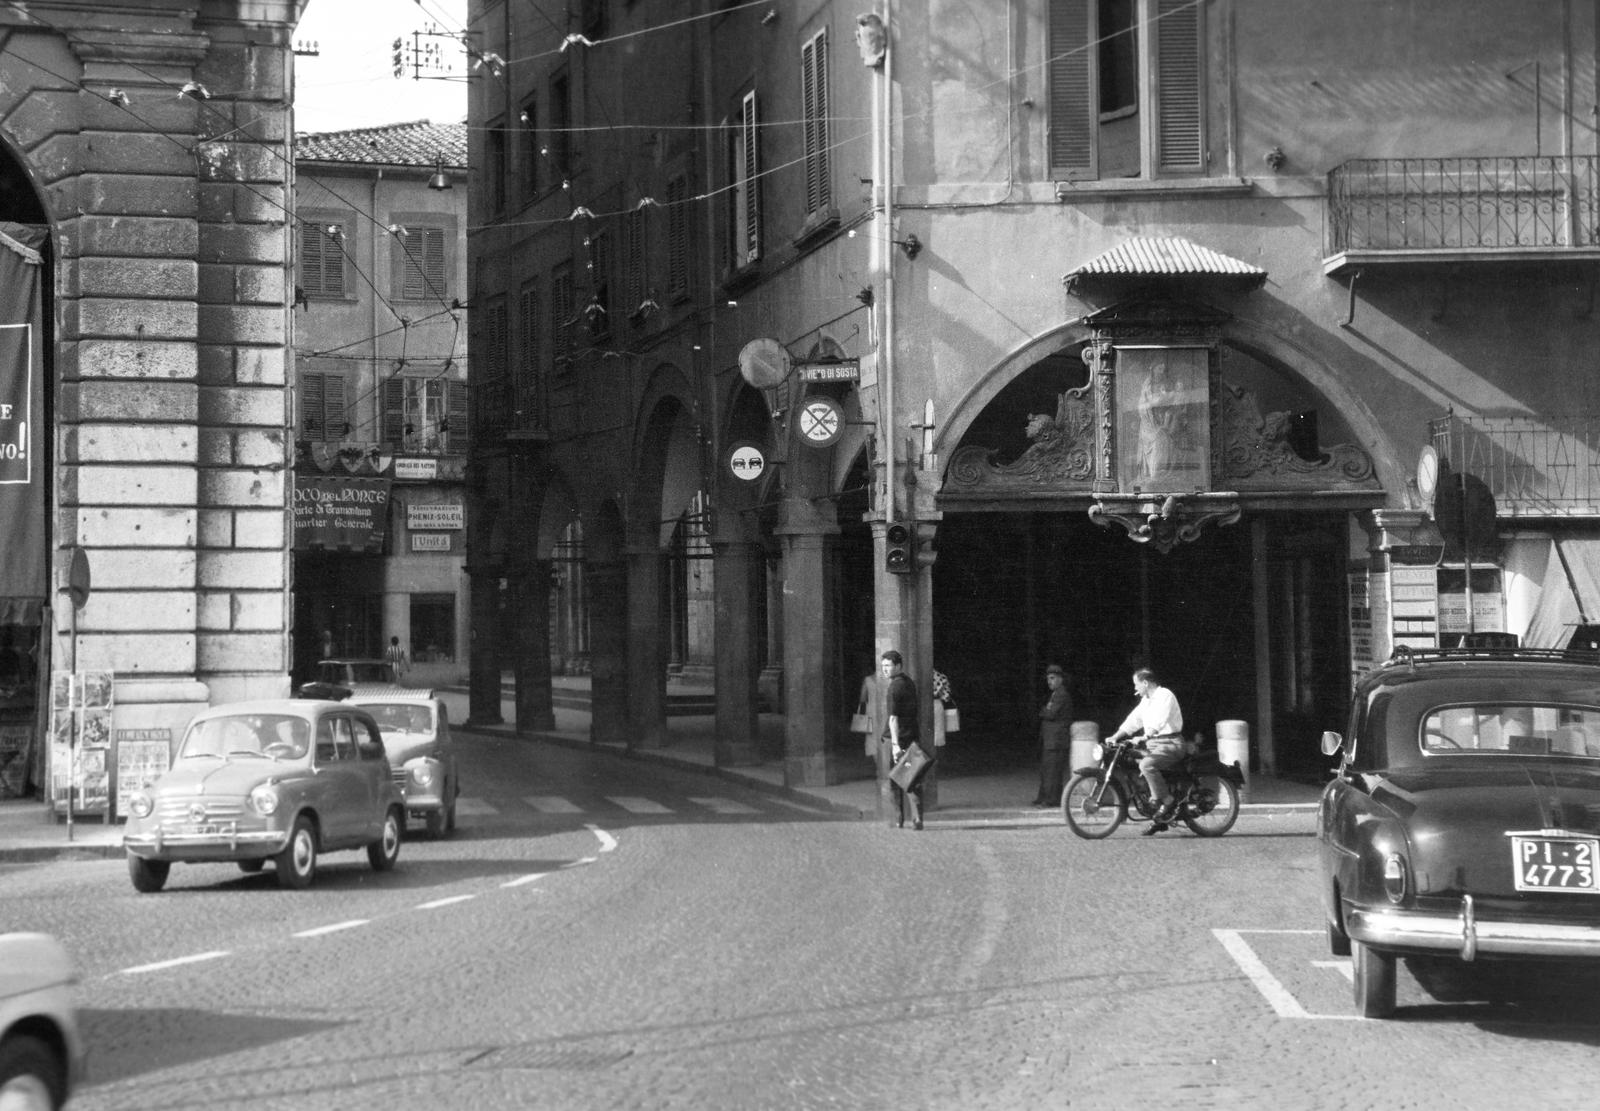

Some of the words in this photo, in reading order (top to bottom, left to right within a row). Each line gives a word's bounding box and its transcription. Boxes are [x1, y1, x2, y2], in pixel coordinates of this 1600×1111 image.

[836, 367, 858, 378] SOSTA
[408, 513, 463, 521] PHENIX-SOLEIL
[334, 517, 374, 530] Generale
[1525, 865, 1592, 888] 4773
